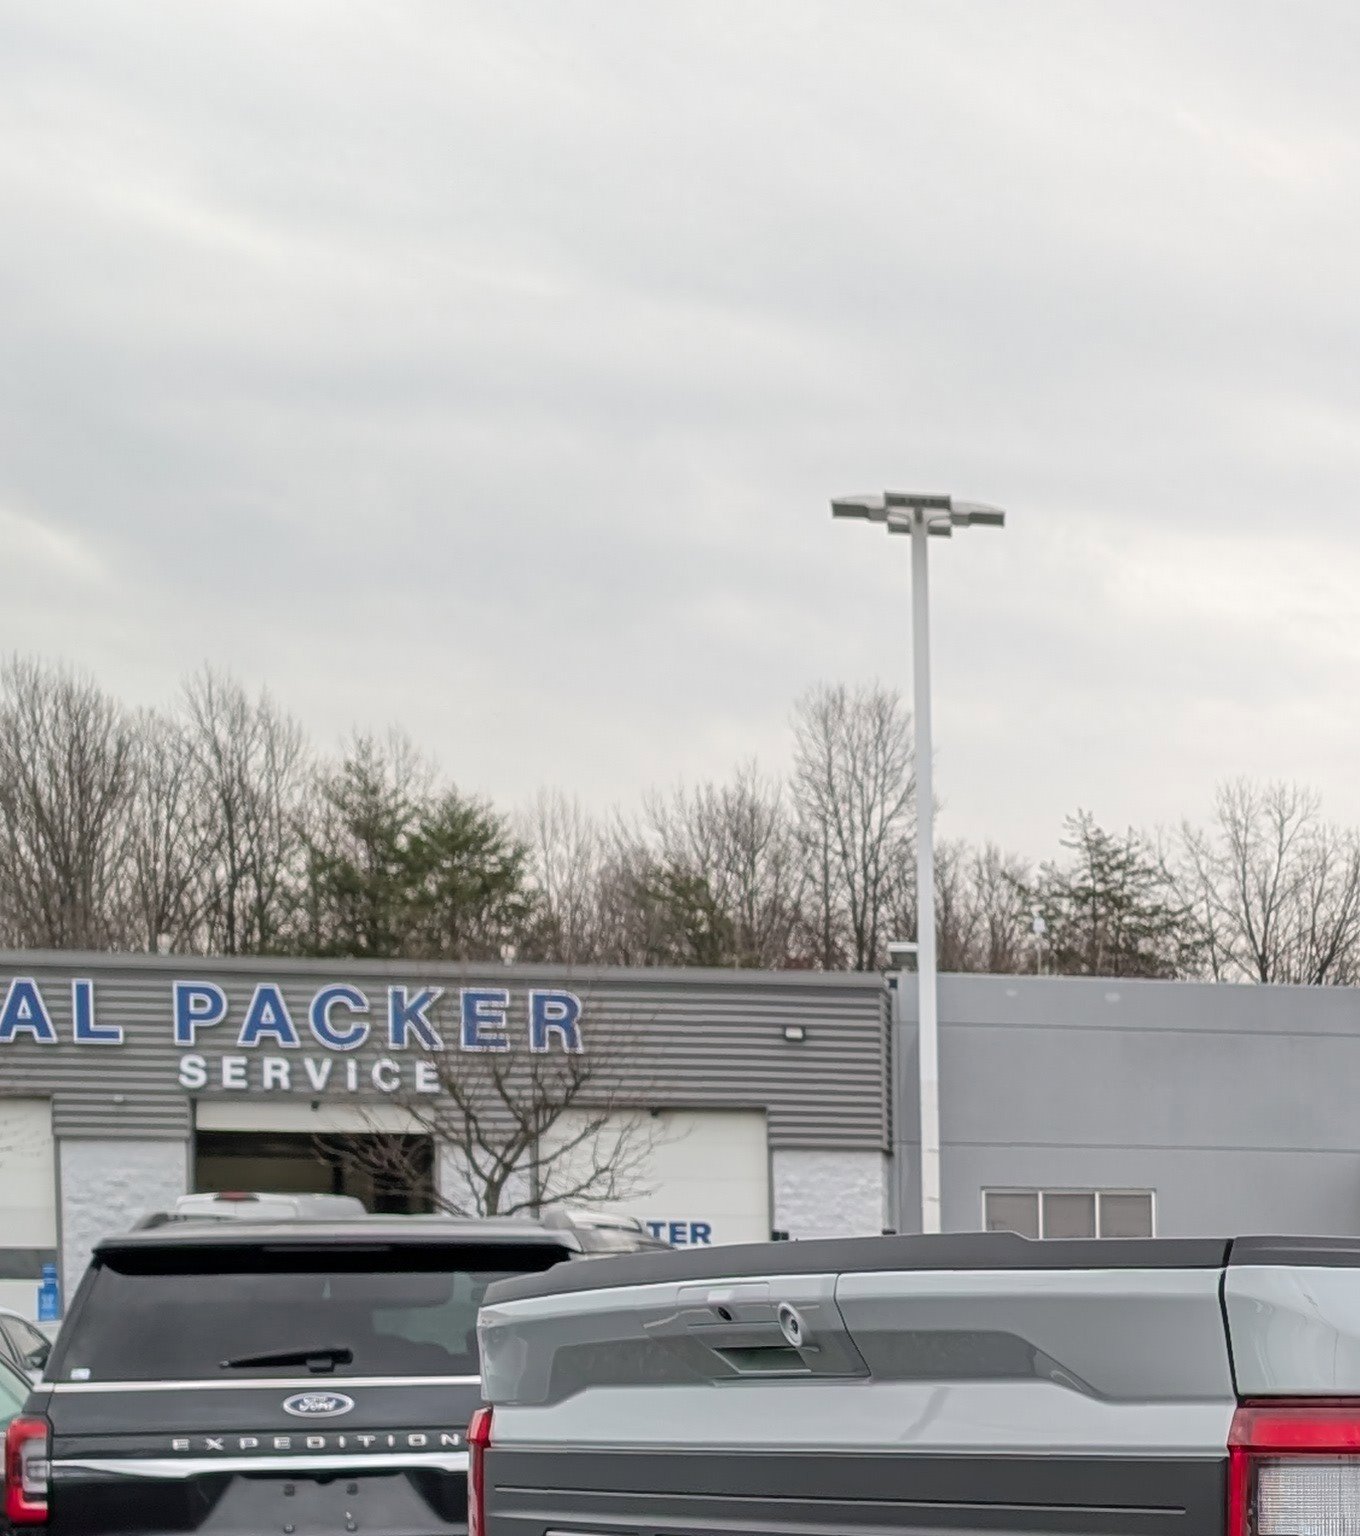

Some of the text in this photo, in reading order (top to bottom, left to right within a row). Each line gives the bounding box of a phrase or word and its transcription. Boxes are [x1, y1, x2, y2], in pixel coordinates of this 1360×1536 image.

[0, 976, 584, 1054] AL PACKER
[178, 1054, 442, 1093] SERVICE
[646, 1221, 712, 1245] TER
[172, 1432, 460, 1452] EXPEDITION
